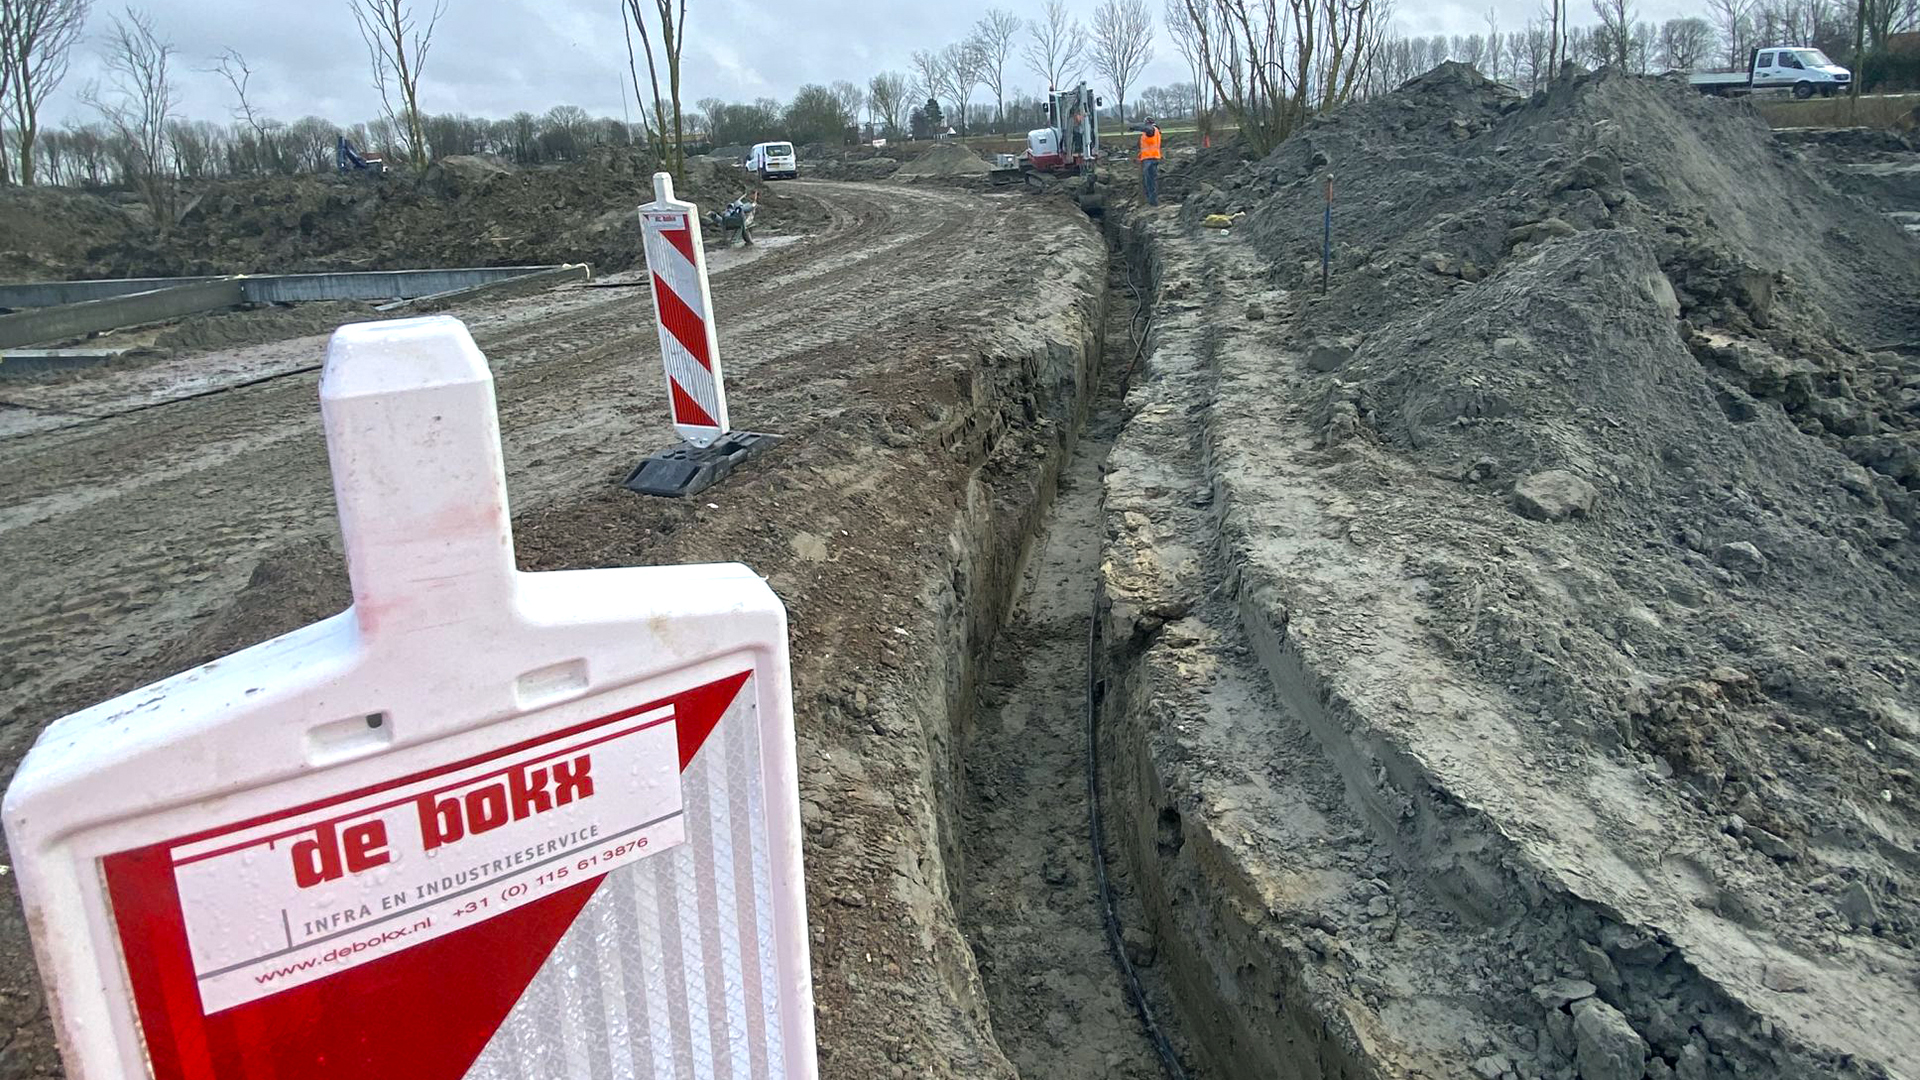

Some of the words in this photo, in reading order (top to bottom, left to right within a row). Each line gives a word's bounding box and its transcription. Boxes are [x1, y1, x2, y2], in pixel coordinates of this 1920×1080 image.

[291, 818, 390, 888] de
[417, 754, 594, 850] bokx
[255, 917, 432, 984] www.debokx.nl
[453, 898, 489, 918] +31
[501, 883, 528, 901] (0)
[536, 867, 569, 886] 115
[304, 905, 372, 936] INFRA
[382, 892, 407, 910] EN
[416, 824, 599, 900] INDUSTRIESERVICE
